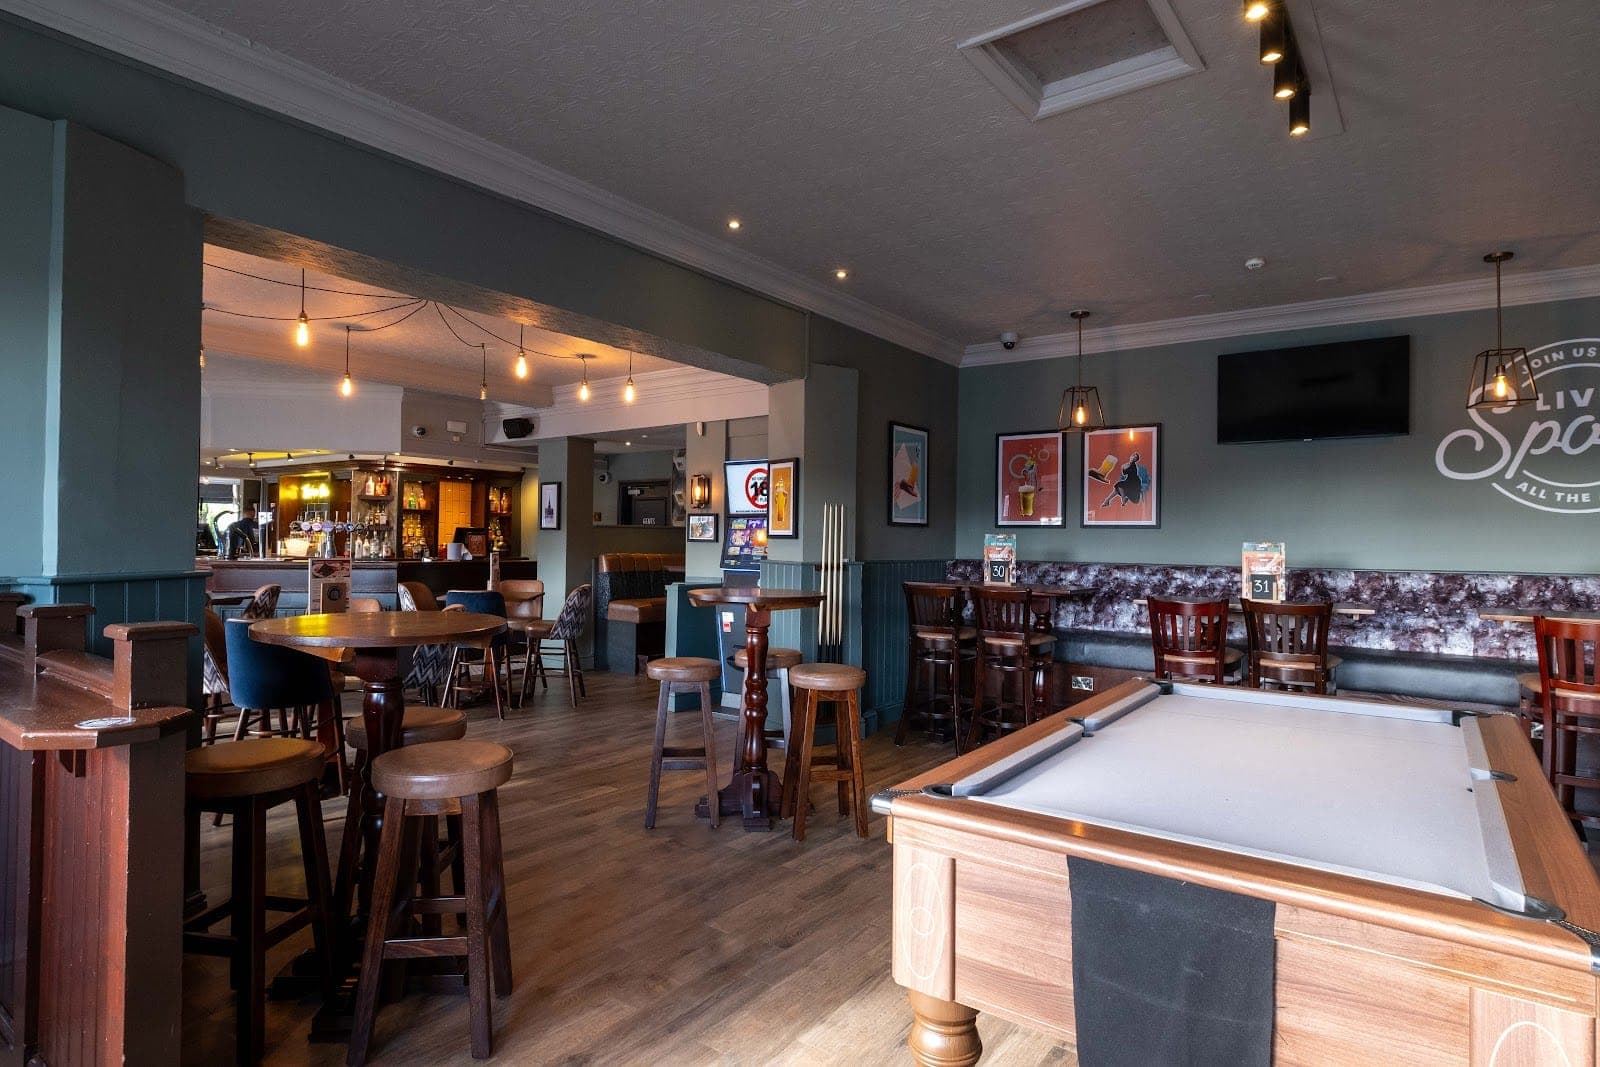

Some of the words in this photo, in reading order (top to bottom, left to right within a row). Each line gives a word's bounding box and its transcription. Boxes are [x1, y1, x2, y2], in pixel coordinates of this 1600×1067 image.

[1522, 350, 1564, 374] JOIN
[1572, 347, 1597, 357] US
[1515, 481, 1546, 499] ALL
[1554, 491, 1591, 503] THE
[992, 565, 1005, 578] 30
[1253, 579, 1270, 593] 31
